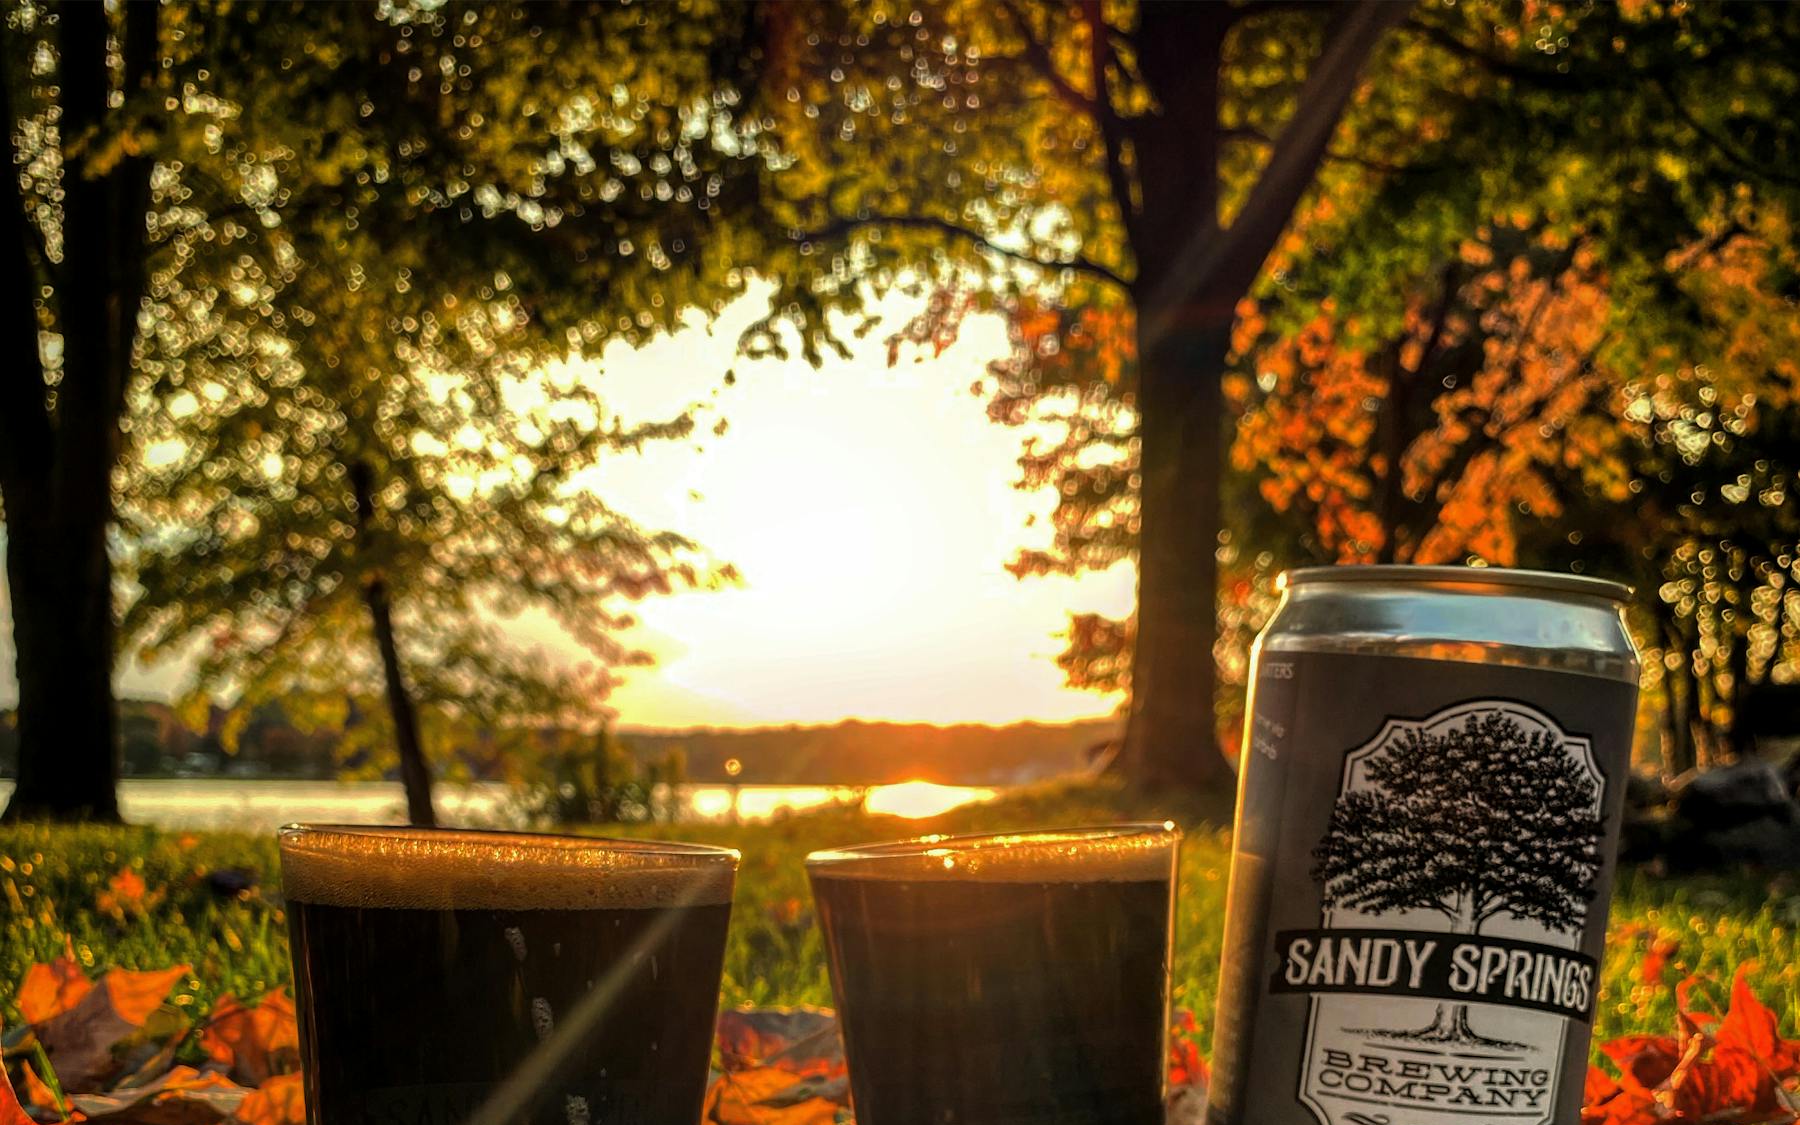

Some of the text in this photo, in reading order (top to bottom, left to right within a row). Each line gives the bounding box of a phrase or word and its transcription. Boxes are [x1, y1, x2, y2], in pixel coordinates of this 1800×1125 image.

[1285, 937, 1594, 1013] SANDY SPRINGS
[1322, 1049, 1548, 1087] BREWING
[1318, 1069, 1548, 1107] COMPANY
